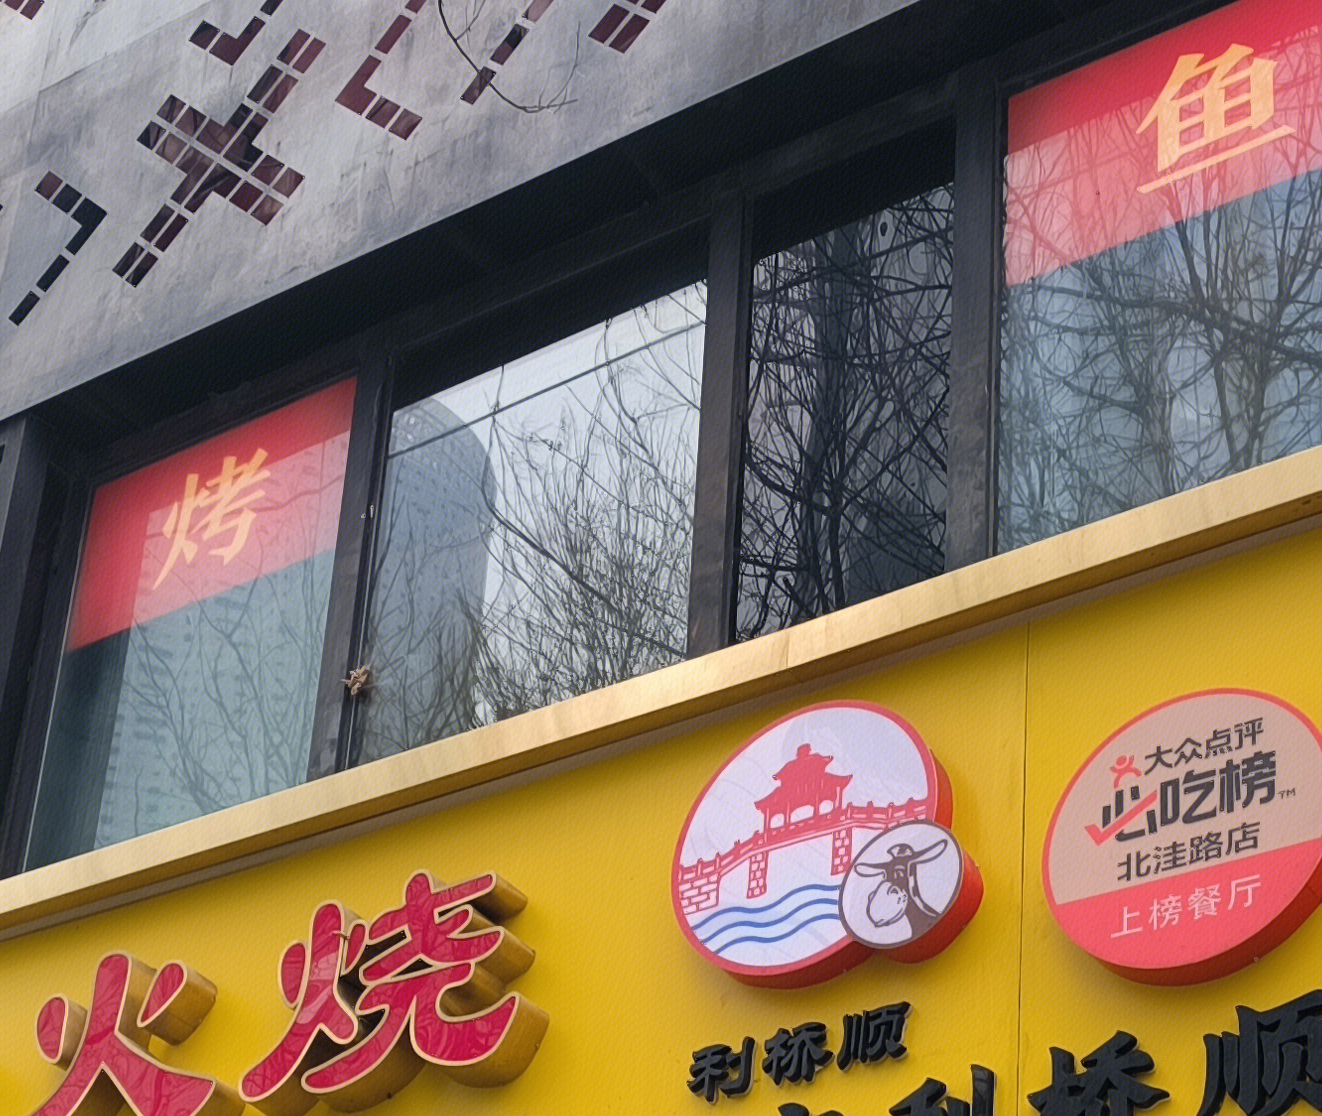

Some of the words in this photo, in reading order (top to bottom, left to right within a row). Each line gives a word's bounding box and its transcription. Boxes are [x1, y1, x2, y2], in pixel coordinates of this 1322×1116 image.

[1136, 43, 1297, 194] 鱼
[152, 447, 271, 591] 烤
[1144, 716, 1265, 776] 大众点评
[1083, 750, 1277, 847] 必吃榜
[1117, 821, 1261, 882] 北洼路店
[1110, 873, 1262, 939] 上榜餐厅
[686, 1002, 912, 1102] 利桥顺
